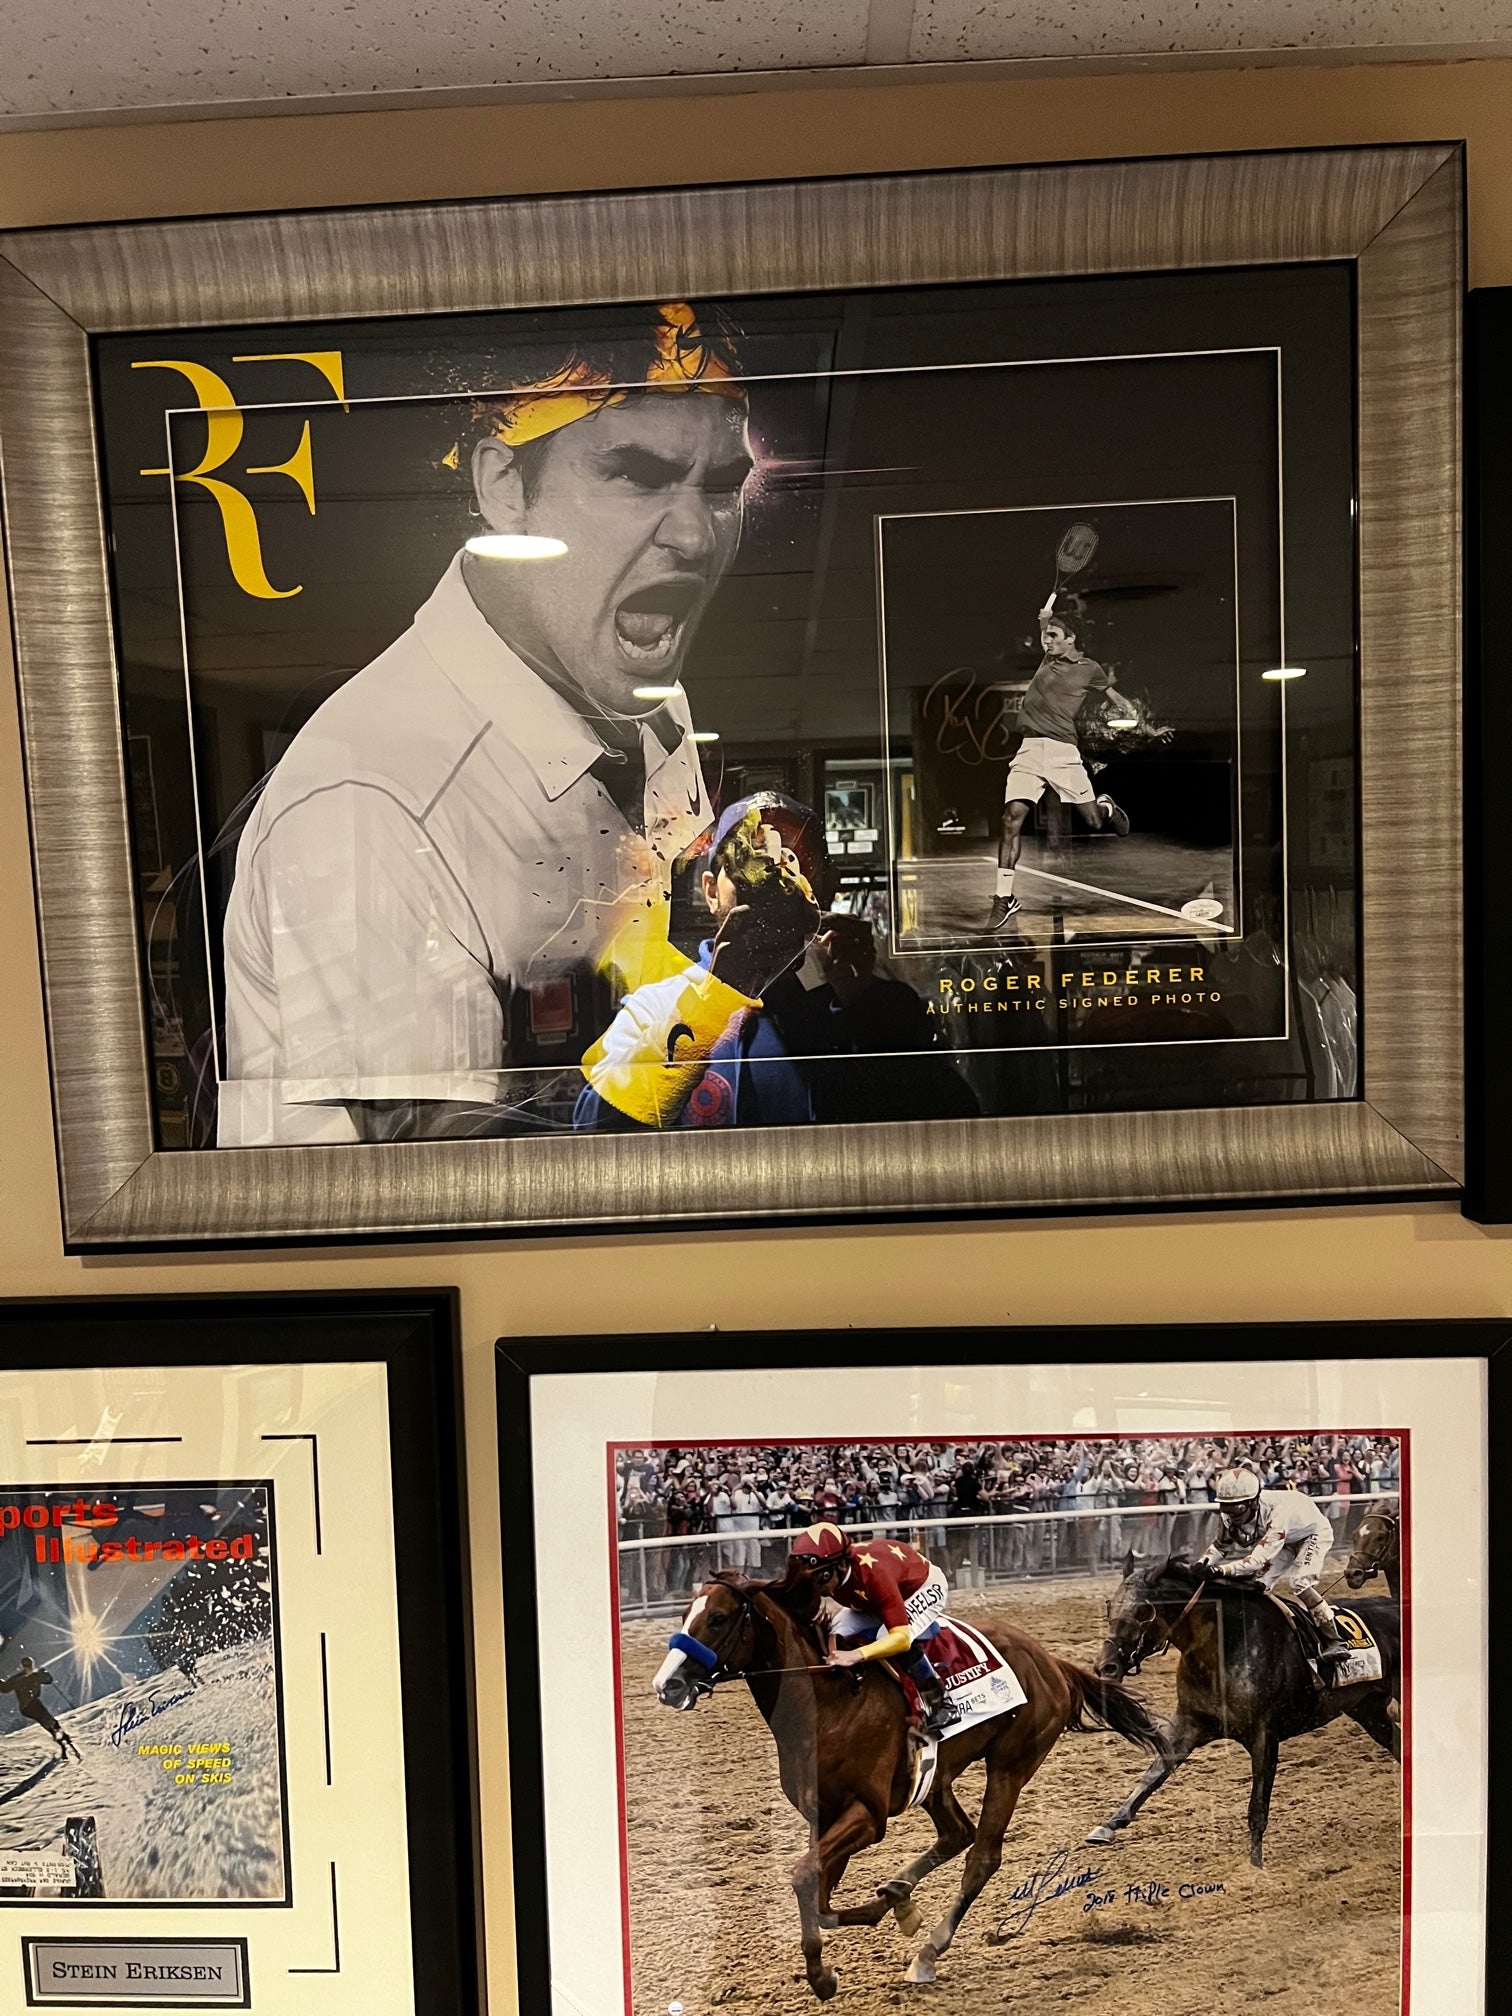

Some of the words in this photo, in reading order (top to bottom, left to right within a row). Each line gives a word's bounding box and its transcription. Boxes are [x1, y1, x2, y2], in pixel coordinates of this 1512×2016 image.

[131, 351, 350, 599] RF
[939, 974, 1042, 993] ROGER
[1061, 967, 1205, 988] FEDERER
[925, 1000, 1046, 1015] AUTHENTIC
[1059, 995, 1138, 1009] SIGNED
[1151, 992, 1222, 1005] PHOTO
[0, 1498, 119, 1537] ports
[35, 1534, 254, 1564] Illustrated
[945, 1662, 991, 1690] JUSTIFY
[138, 1744, 182, 1755] MAGIC
[188, 1742, 231, 1754] VIEWS
[163, 1759, 182, 1770] OF
[187, 1758, 232, 1769] SPEED
[175, 1773, 195, 1784] ON
[201, 1773, 233, 1783] SKIS
[52, 1961, 117, 1979] STEIN
[125, 1962, 223, 1980] ERIKSEN
